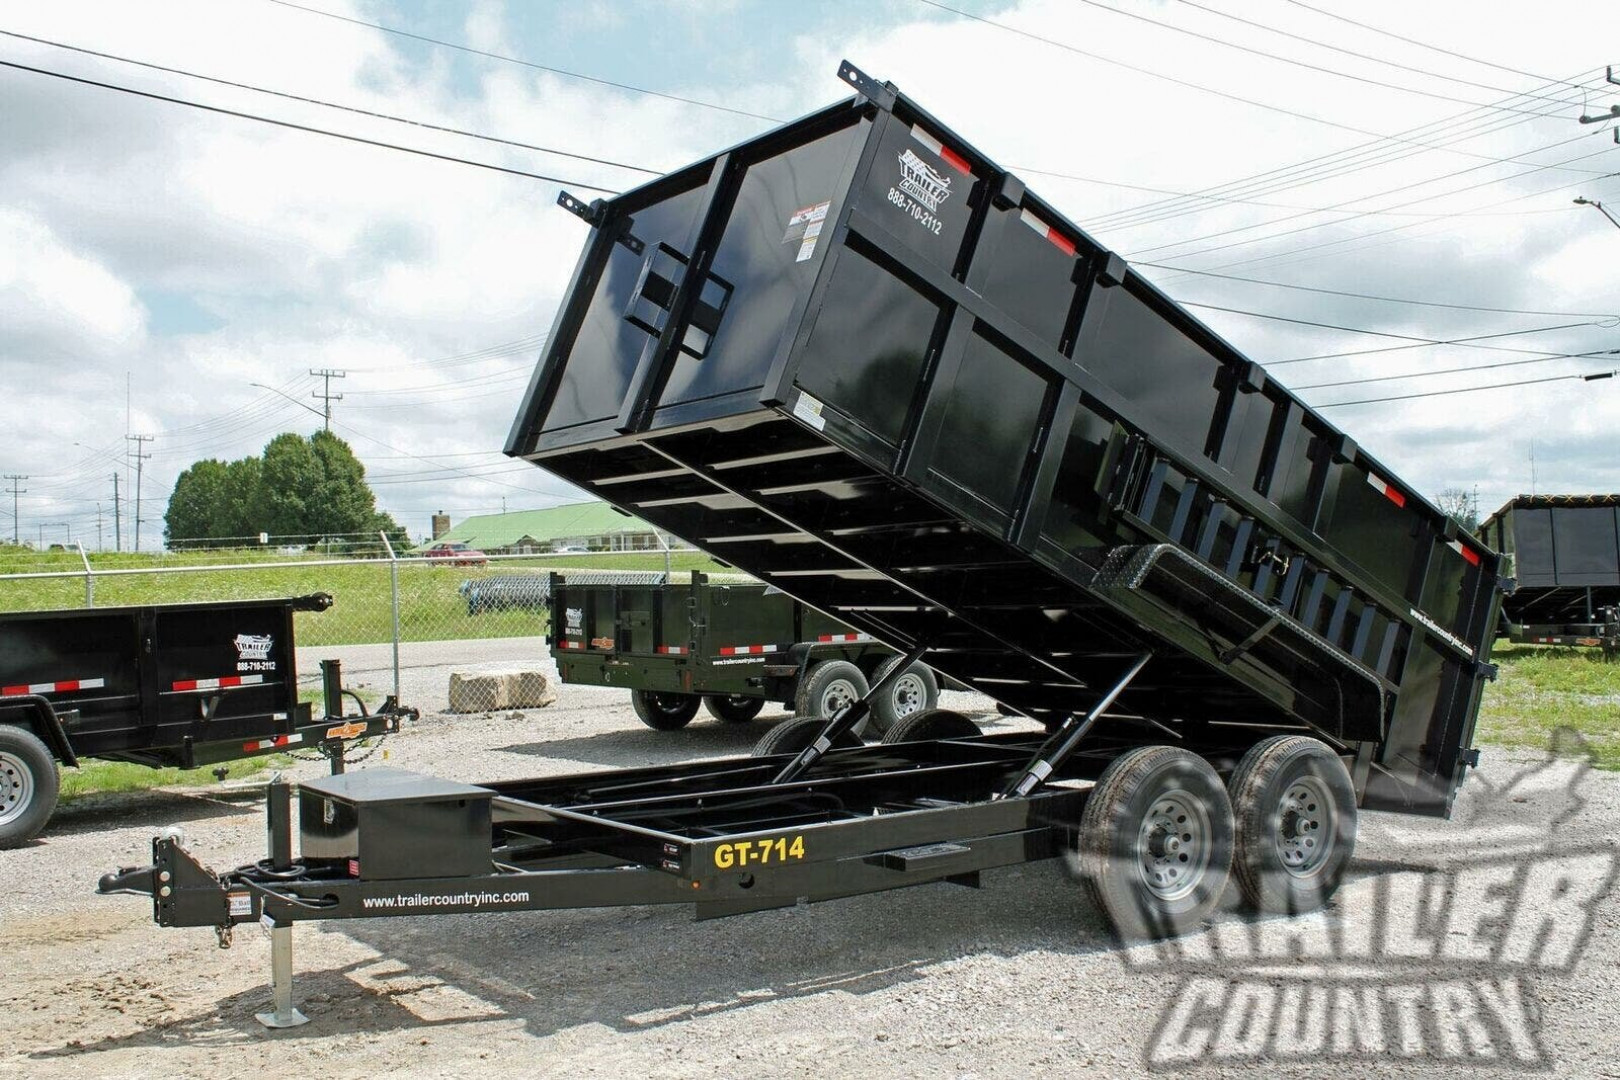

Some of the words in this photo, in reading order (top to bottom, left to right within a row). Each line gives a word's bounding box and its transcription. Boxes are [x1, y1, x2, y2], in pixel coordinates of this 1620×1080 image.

[899, 157, 950, 203] TRAILER
[887, 187, 942, 235] 888-710-2112
[714, 835, 805, 869] GT-714
[363, 891, 529, 908] www.trailercountryinc.com
